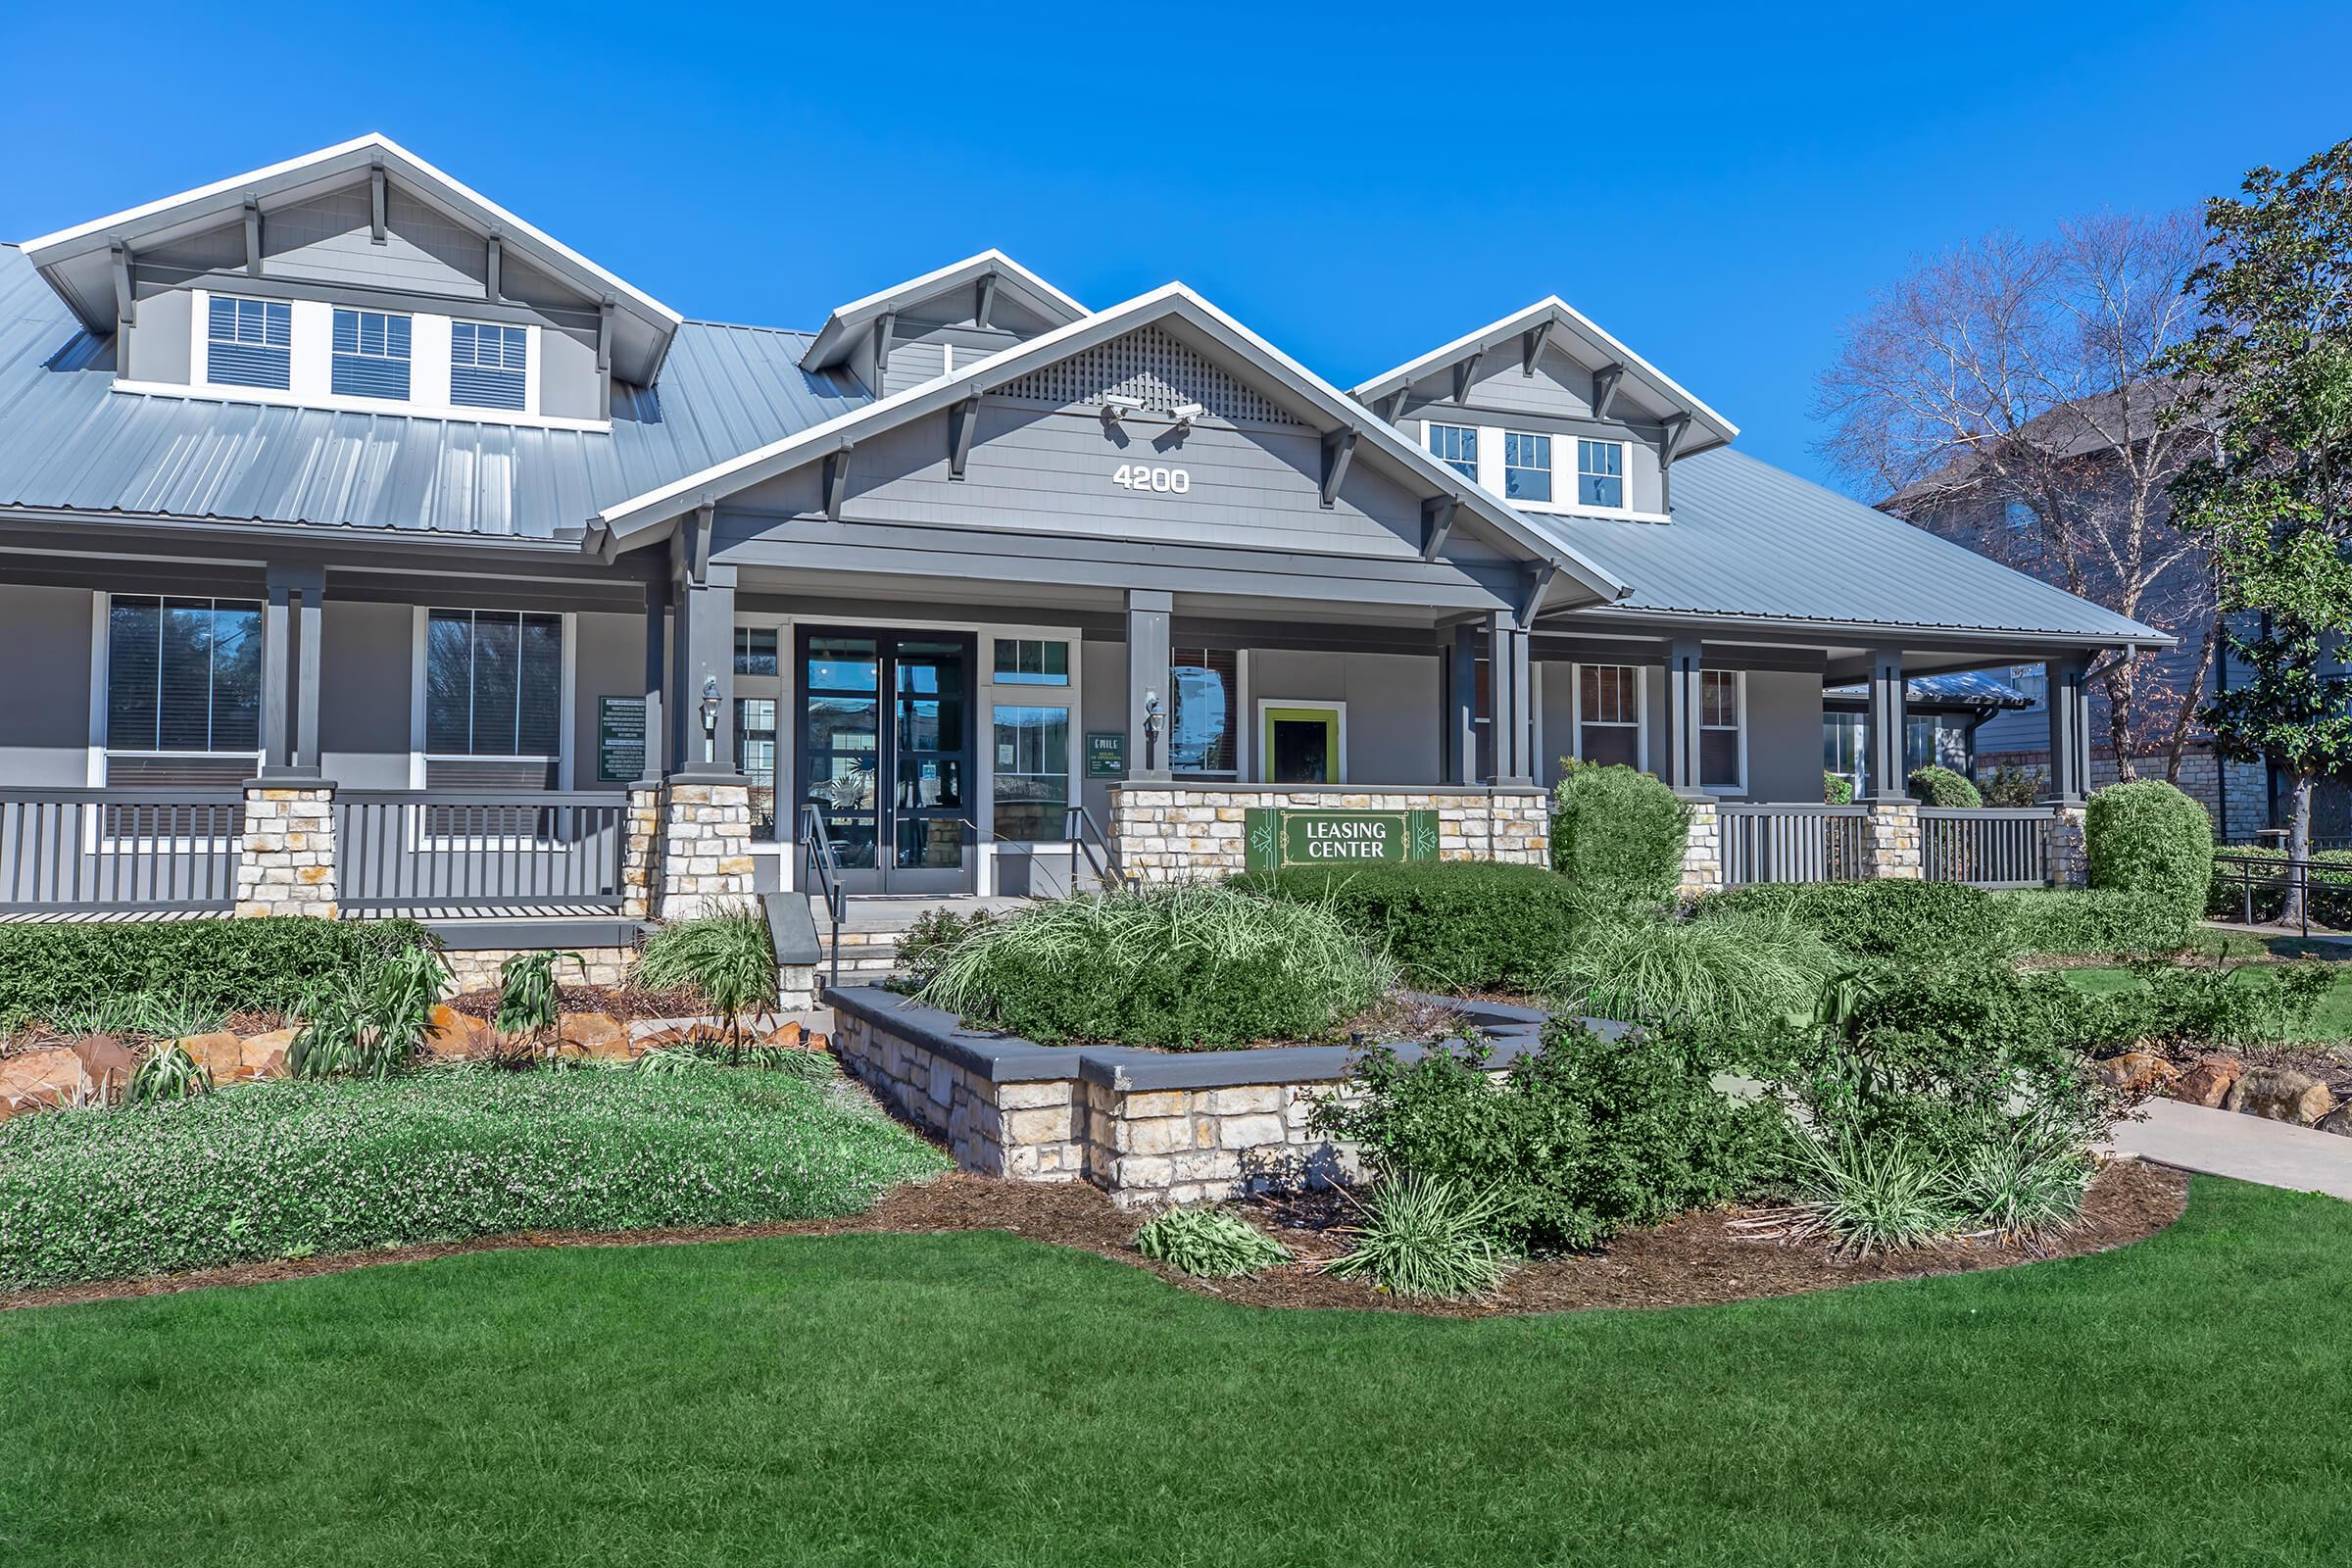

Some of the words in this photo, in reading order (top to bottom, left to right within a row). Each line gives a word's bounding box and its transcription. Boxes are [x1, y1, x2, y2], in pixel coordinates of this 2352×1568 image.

[1112, 465, 1190, 494] 4200
[1306, 822, 1387, 839] LEASING
[1308, 841, 1385, 858] CENTER
